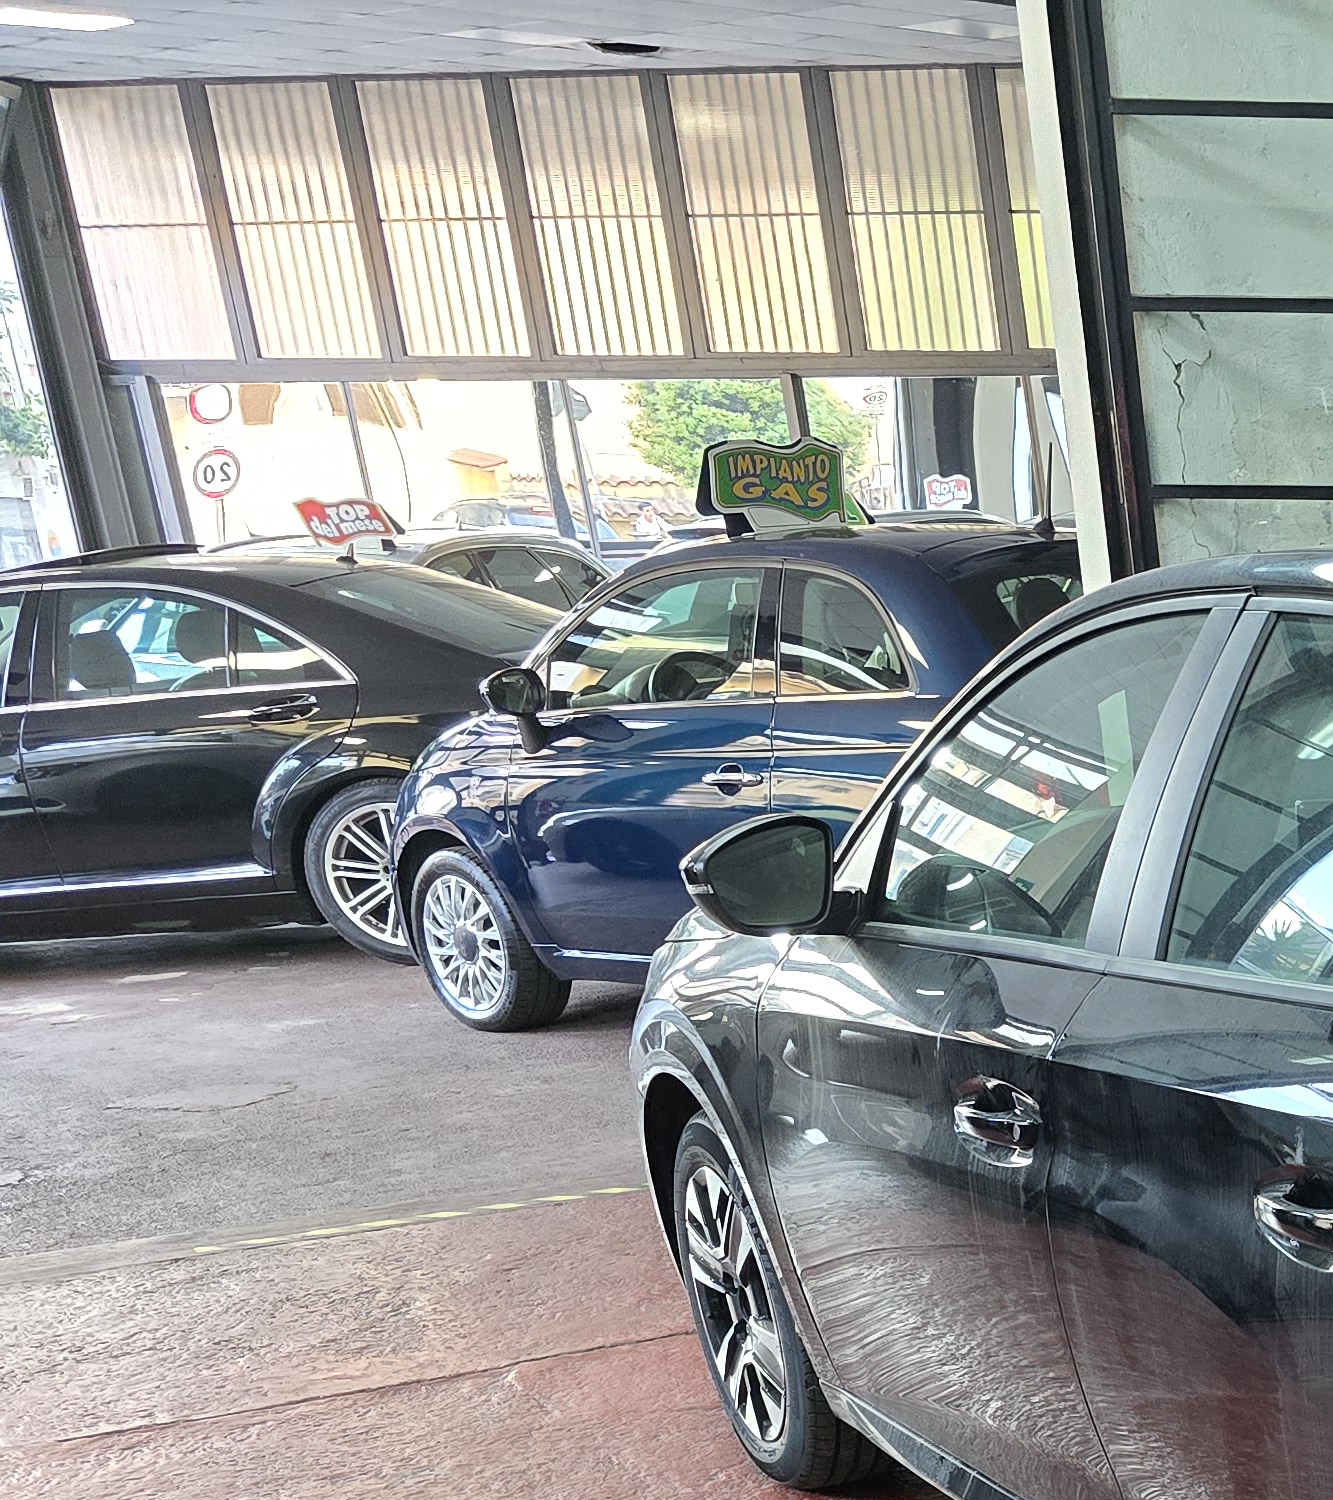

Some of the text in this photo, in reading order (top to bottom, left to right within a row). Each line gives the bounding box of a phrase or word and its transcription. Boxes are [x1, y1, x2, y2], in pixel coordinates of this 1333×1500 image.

[728, 453, 831, 483] IMPIANTO
[732, 477, 830, 508] GAS
[310, 515, 386, 538] del mese
[324, 504, 370, 524] TOP
